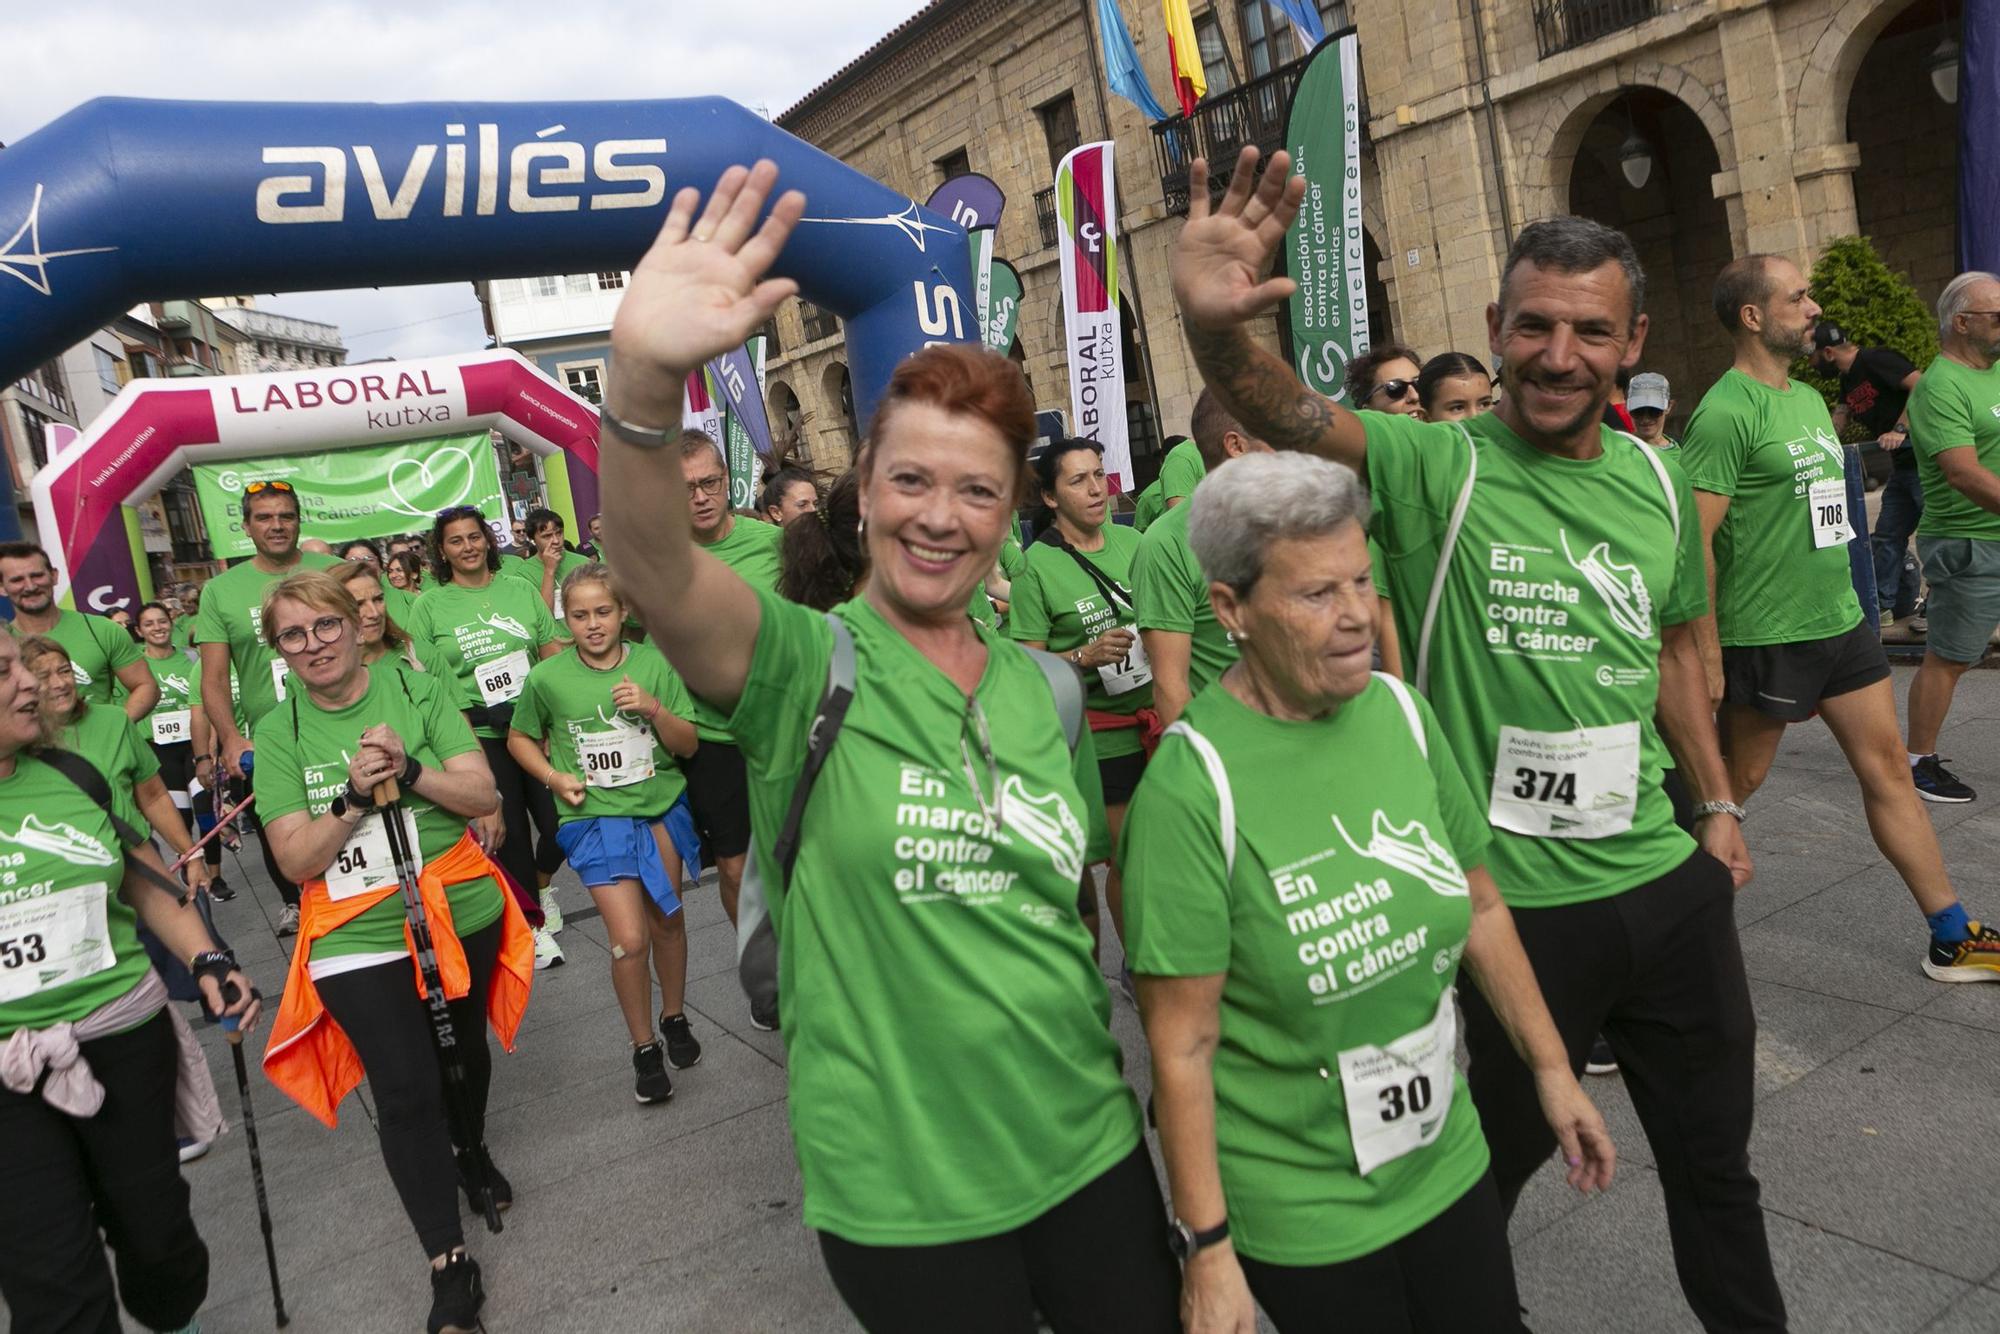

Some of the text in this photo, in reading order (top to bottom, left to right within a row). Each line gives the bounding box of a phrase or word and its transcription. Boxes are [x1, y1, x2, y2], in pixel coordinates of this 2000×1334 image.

[256, 123, 667, 225] avilés
[1296, 146, 1313, 328] asociación espola
[1311, 181, 1327, 328] contra el cáncer
[1330, 226, 1341, 328] en Asturias
[1100, 322, 1114, 380] kutxa
[231, 370, 447, 414] LABORAL
[1078, 324, 1101, 446] ABORAL
[367, 404, 451, 430] kutxa
[1788, 443, 1806, 456] En
[1793, 451, 1826, 470] marcha
[1795, 465, 1824, 482] contra
[1794, 481, 1806, 495] el
[316, 502, 379, 521] cáncer
[1817, 503, 1843, 527] 708
[1489, 548, 1526, 573] En
[1488, 578, 1581, 605] marcha
[1076, 600, 1095, 614] En
[1487, 603, 1569, 627] contra
[454, 627, 469, 636] En
[457, 629, 495, 644] marcha
[1085, 618, 1118, 635] contra
[1486, 623, 1599, 653] el cáncer
[460, 637, 492, 652] contra
[463, 642, 506, 660] el cáncer
[485, 671, 512, 693] 688
[158, 722, 180, 735] 509
[587, 750, 622, 771] 300
[305, 770, 324, 785] En
[900, 768, 945, 798] En
[1512, 766, 1577, 807] 374
[338, 846, 367, 875] 54
[895, 836, 993, 864] contra
[0, 880, 55, 904] ncer
[895, 863, 1018, 895] el cáncer
[1274, 871, 1319, 906] En
[1286, 877, 1394, 936] marcha
[0, 933, 47, 969] 53
[1298, 911, 1391, 967] contra
[1307, 963, 1339, 996] el
[1346, 924, 1429, 985] cáncer
[1378, 1075, 1432, 1122] 30
